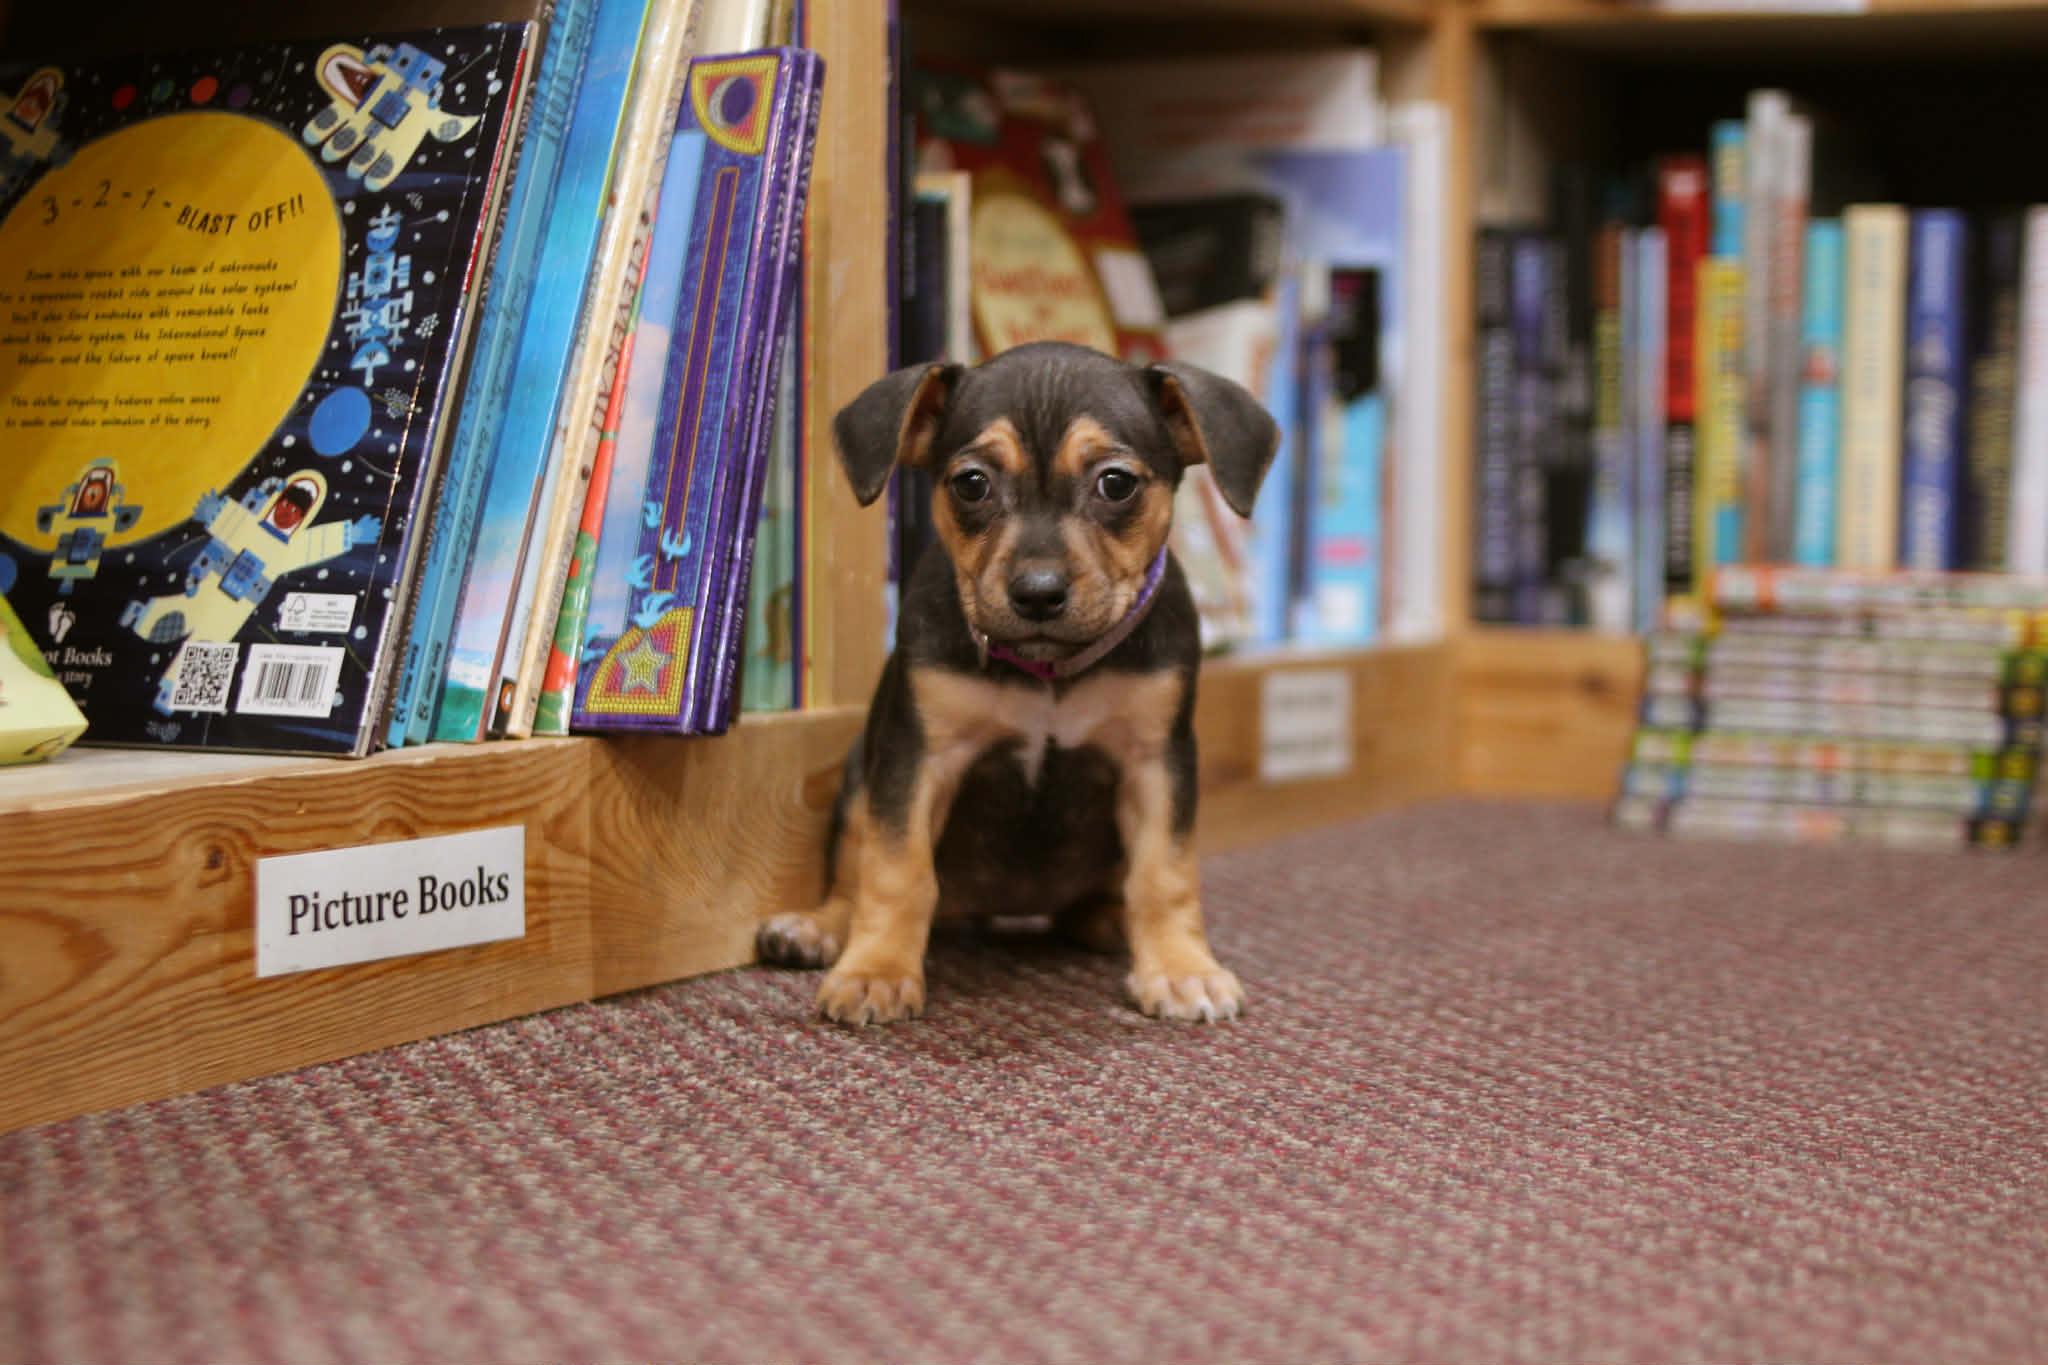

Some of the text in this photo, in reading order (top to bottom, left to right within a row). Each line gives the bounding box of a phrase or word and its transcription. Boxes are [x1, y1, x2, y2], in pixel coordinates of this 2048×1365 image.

[42, 195, 59, 224] 3
[93, 179, 111, 208] 2
[140, 187, 155, 209] 1
[177, 204, 237, 236] BLAST
[247, 193, 304, 233] OFF!!
[84, 268, 114, 283] space
[121, 264, 141, 277] with
[171, 264, 196, 276] team
[203, 261, 214, 272] of
[220, 259, 278, 272] astronauts
[90, 287, 124, 300] rocket
[129, 287, 149, 297] ride
[157, 287, 194, 296] around
[200, 283, 215, 296] the
[223, 281, 248, 294] solar
[254, 280, 298, 298] system!
[68, 308, 89, 320] find
[149, 305, 169, 318] with
[176, 303, 234, 317] remarkable
[241, 302, 270, 315] facts
[603, 239, 642, 369] CLEVER
[36, 331, 52, 343] the
[58, 330, 82, 343] solar
[134, 328, 149, 341] the
[158, 325, 229, 340] International
[234, 325, 266, 342] Space
[60, 352, 81, 363] and
[85, 351, 102, 363] the
[107, 350, 141, 363] future
[148, 348, 159, 361] of
[164, 352, 195, 367] space
[114, 394, 153, 406] features
[48, 416, 68, 427] and
[149, 412, 161, 425] of
[164, 412, 181, 425] the
[63, 647, 113, 666] Books
[288, 866, 510, 935] Picture Books
